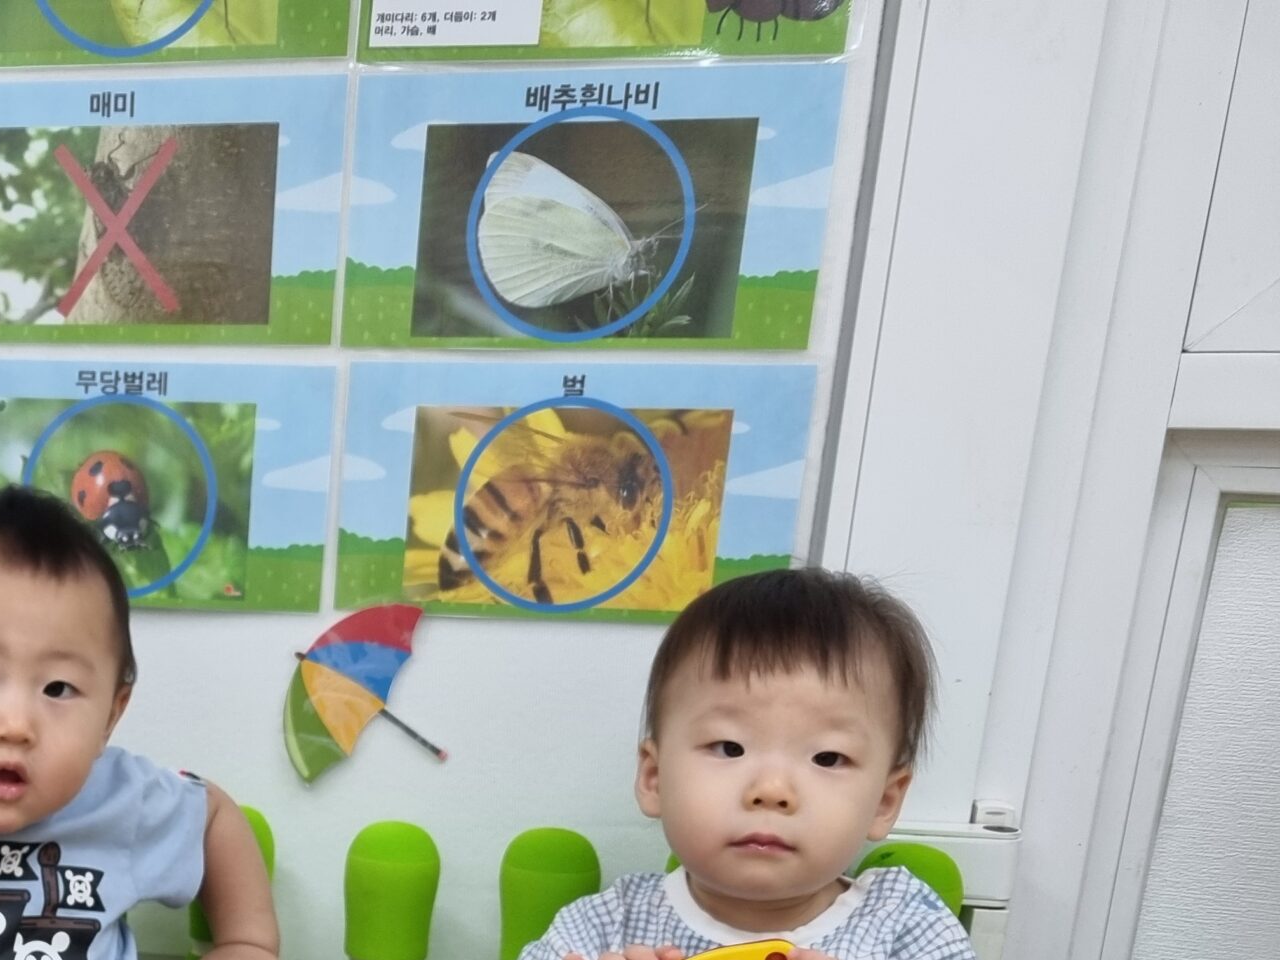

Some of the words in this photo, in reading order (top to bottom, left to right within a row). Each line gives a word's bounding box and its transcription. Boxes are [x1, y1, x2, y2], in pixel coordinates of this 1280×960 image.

[376, 12, 418, 23] 개미다리:
[421, 11, 439, 23] 6개,
[480, 11, 497, 22] 2개
[374, 26, 397, 36] 머리,
[400, 25, 423, 36] 가슴,
[426, 25, 437, 35] 배
[89, 90, 136, 118] 매미
[75, 369, 169, 396] 무당벌레
[562, 374, 586, 397] 벌
